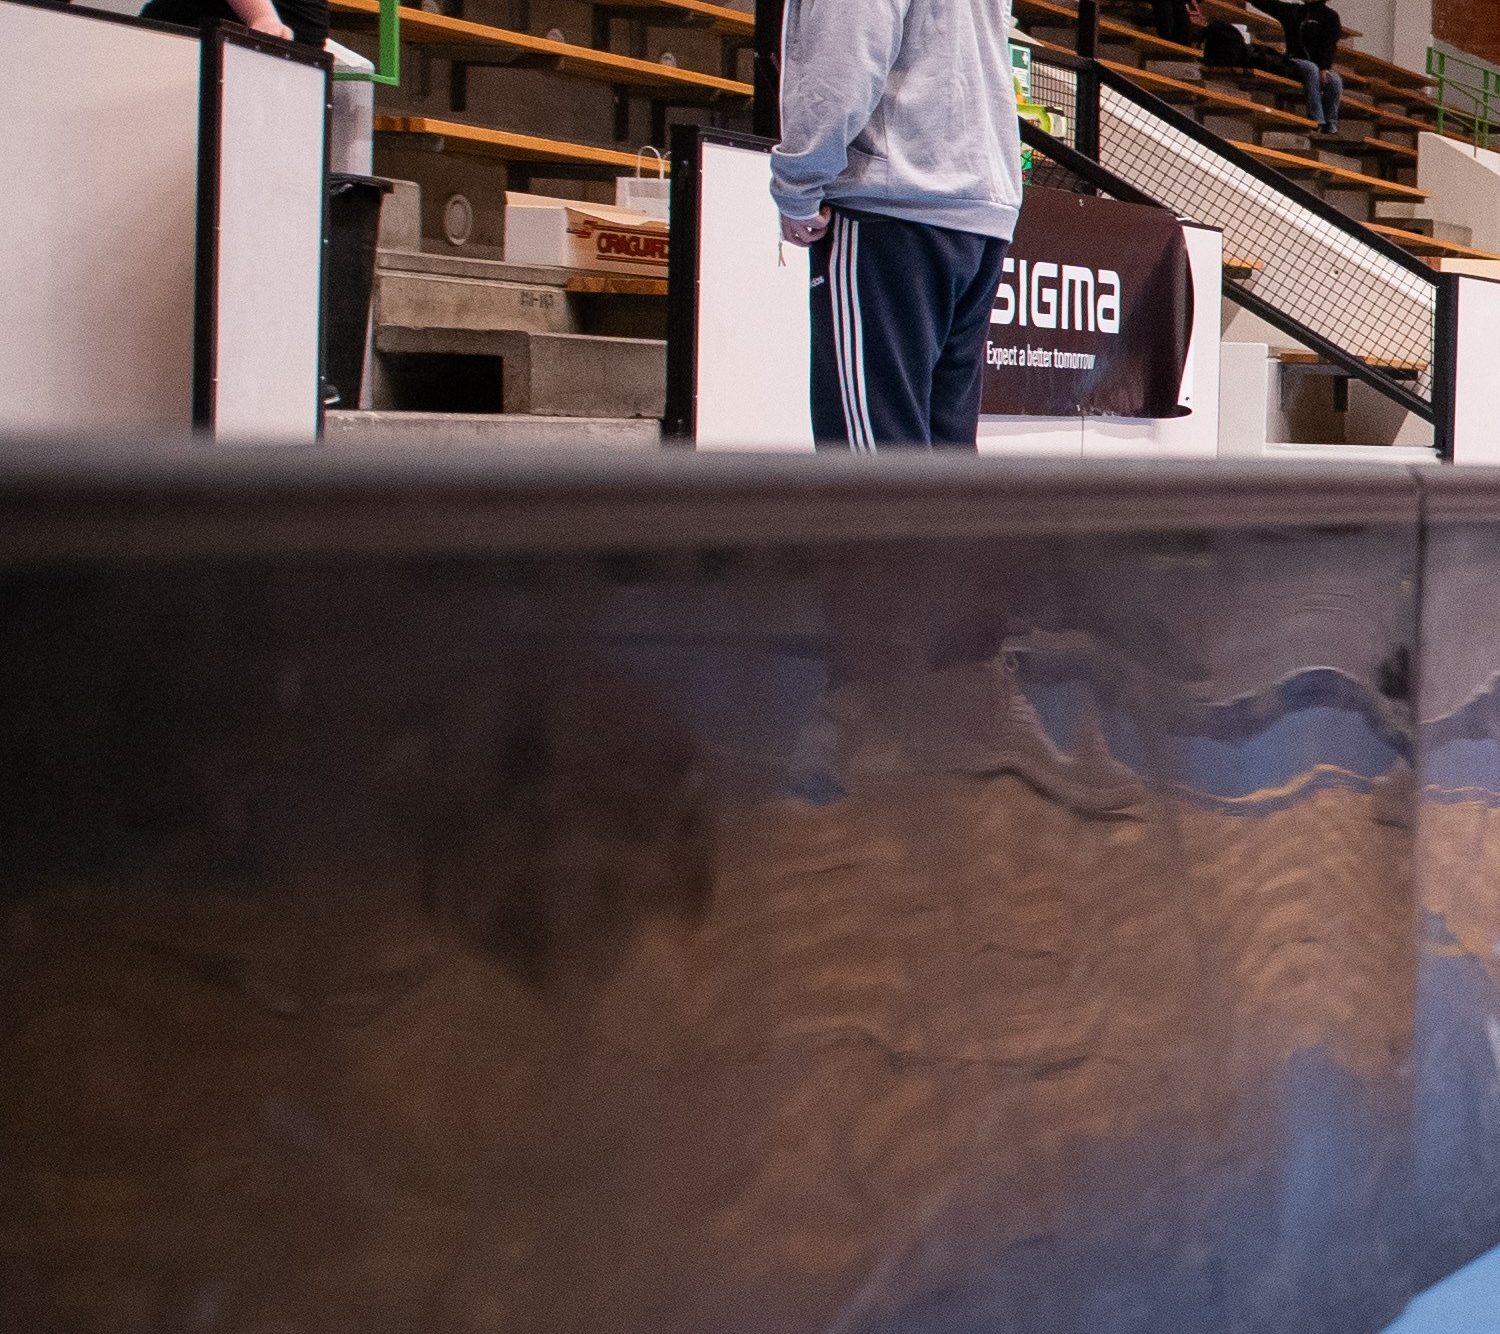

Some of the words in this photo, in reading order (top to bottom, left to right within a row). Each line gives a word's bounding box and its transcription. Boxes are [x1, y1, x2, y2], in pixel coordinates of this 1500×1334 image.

[986, 341, 1017, 370] Expect
[1018, 349, 1026, 366] a
[1026, 344, 1052, 368] better
[1053, 348, 1097, 370] tomorrow
